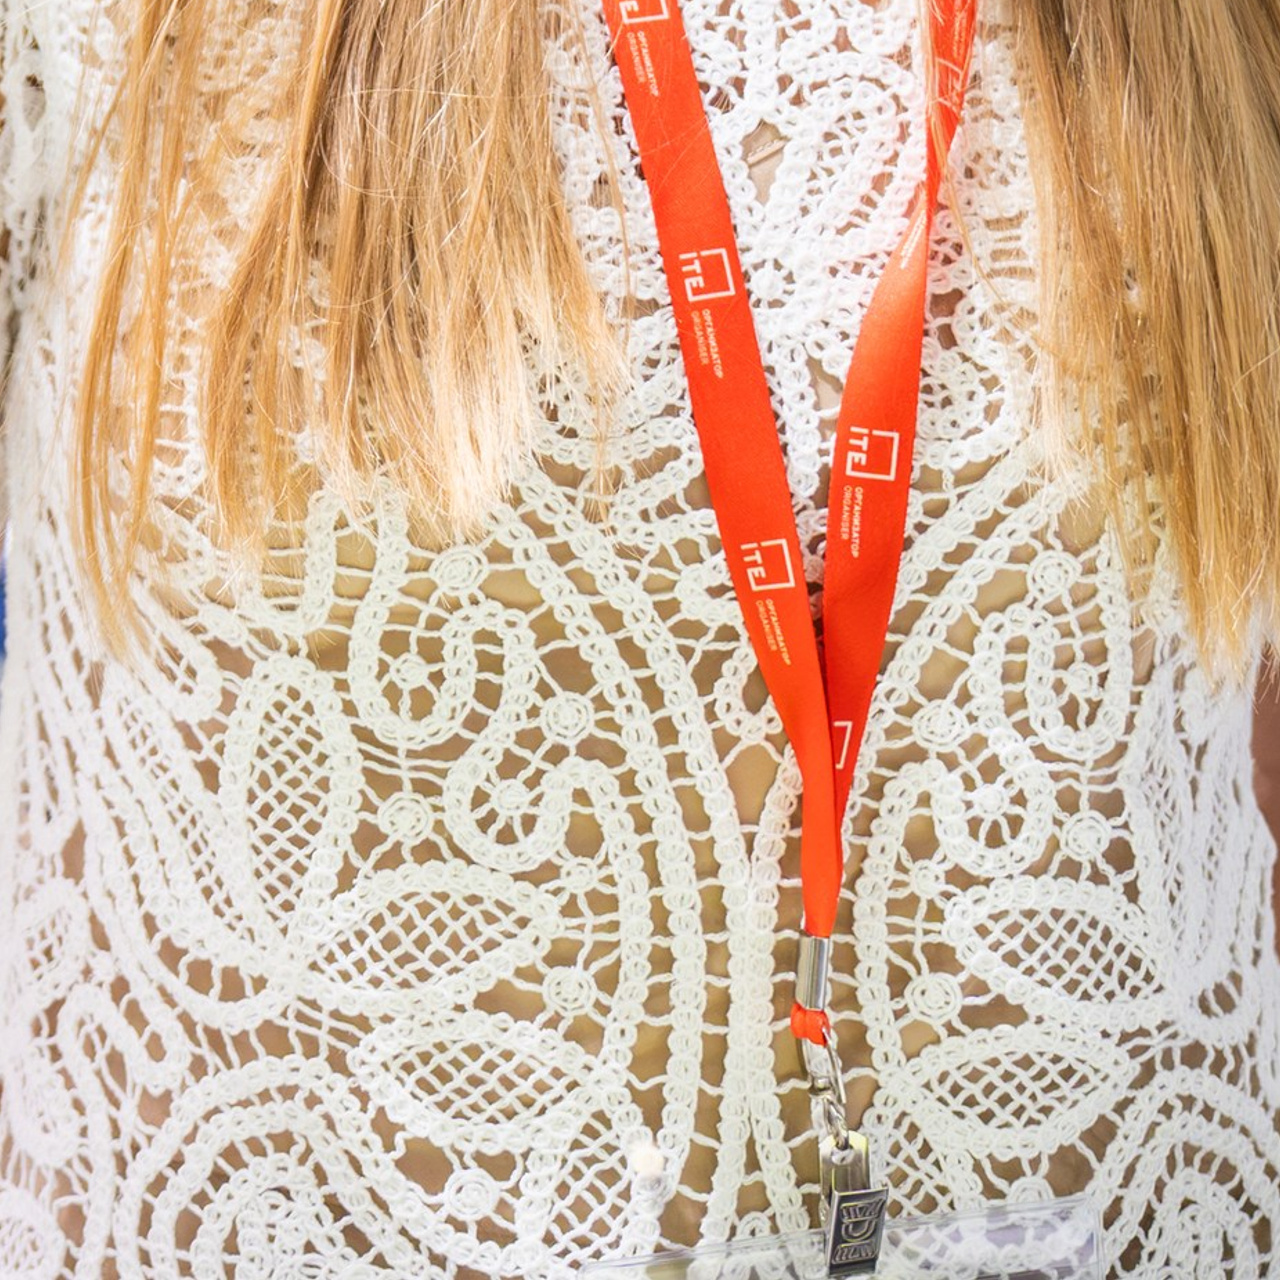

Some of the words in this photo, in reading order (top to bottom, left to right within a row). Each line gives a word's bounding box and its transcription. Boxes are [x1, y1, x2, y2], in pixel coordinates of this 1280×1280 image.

[691, 310, 709, 365] ORGANISER
[702, 308, 723, 379] ОРГАНИЗАТОР
[840, 485, 853, 540] ORGANISER
[850, 486, 863, 558] ОРГАНИЗАТОР
[766, 598, 791, 666] ОРГАНИЗАТОР
